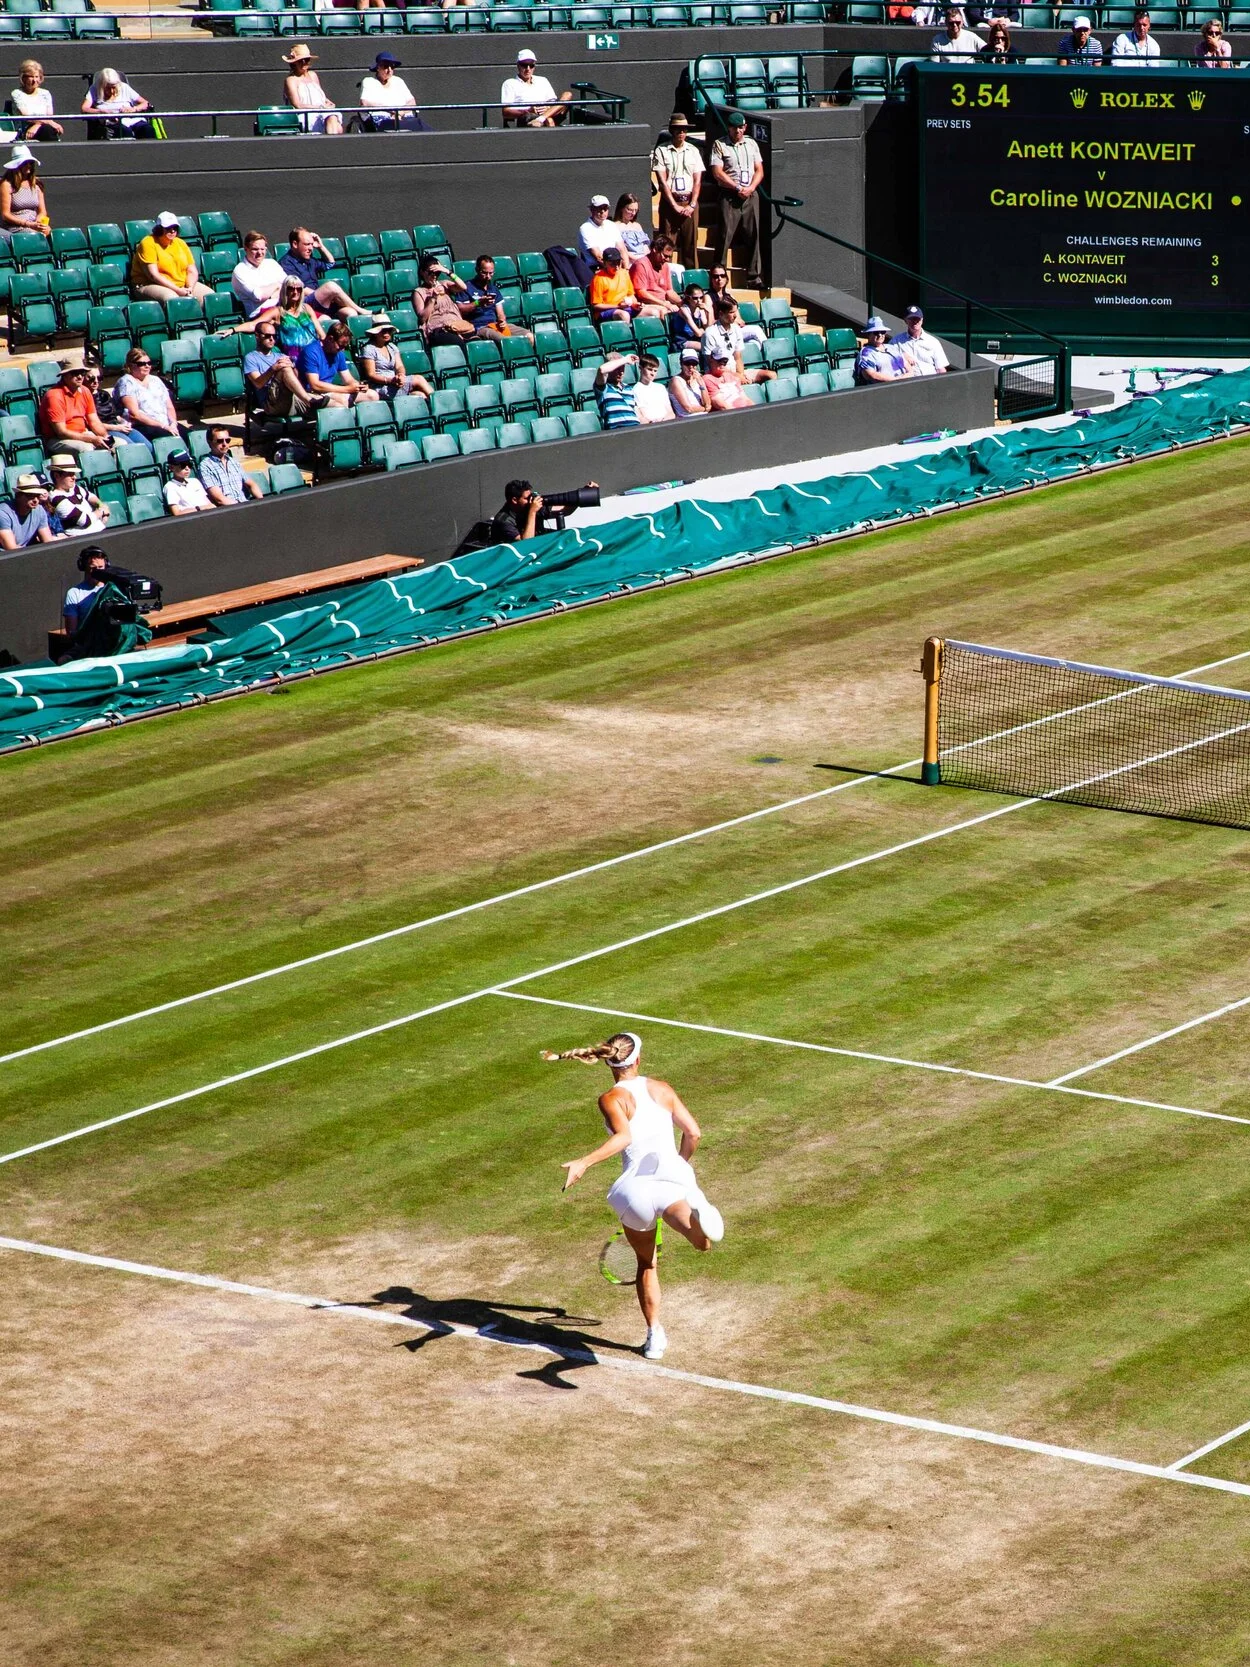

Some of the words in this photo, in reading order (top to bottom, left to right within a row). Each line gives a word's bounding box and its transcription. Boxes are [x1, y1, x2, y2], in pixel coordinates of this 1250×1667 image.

[951, 84, 1011, 108] 3.54
[1100, 92, 1176, 108] ROLEX
[926, 118, 949, 129] PREV
[949, 119, 972, 129] SETS
[1006, 140, 1064, 159] Anett
[1070, 141, 1196, 161] KONTAVEIT
[990, 188, 1079, 208] Caroline
[1084, 190, 1213, 210] WOZNIACKI
[1066, 235, 1139, 247] CHALLENGES
[1140, 236, 1203, 247] REMAINING
[1042, 253, 1056, 264] A.
[1058, 253, 1126, 265] KONTAVEIT
[1211, 254, 1219, 267] 3
[1042, 272, 1056, 283] C.
[1057, 272, 1127, 284] WOZNIACKI
[1211, 274, 1219, 287] 3
[1094, 295, 1173, 306] wimbledon.com
